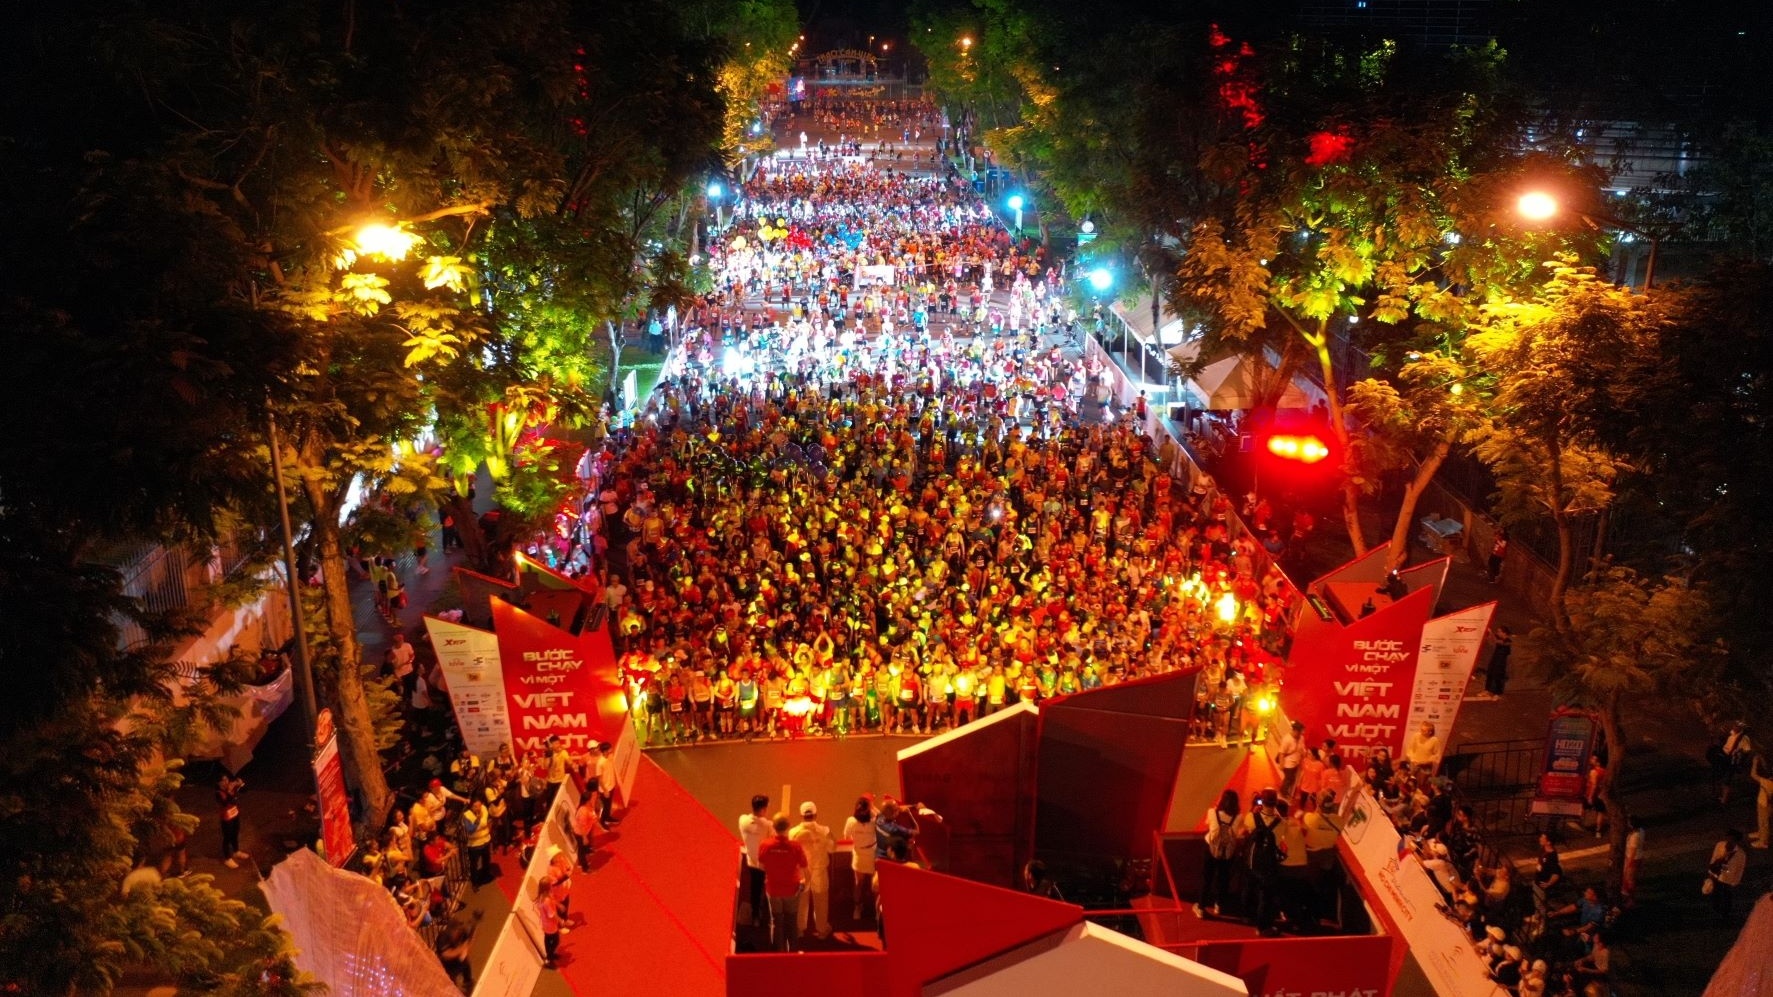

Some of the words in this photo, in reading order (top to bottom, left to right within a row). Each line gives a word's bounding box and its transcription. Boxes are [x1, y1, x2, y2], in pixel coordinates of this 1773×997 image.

[1353, 640, 1404, 651] BƯỚC
[523, 648, 575, 662] BƯỚC
[1364, 652, 1410, 662] CHẠY
[537, 660, 584, 672] CHẠY
[1344, 664, 1360, 672] VÌ
[1361, 664, 1390, 674] MỘT
[520, 675, 535, 684] VÌ
[536, 674, 566, 685] MỘT
[1333, 677, 1394, 700] VIỆT
[512, 688, 574, 712] VIỆT
[1336, 704, 1400, 719] NAM
[522, 713, 588, 731] NAM
[1326, 722, 1397, 742] VƯỢT
